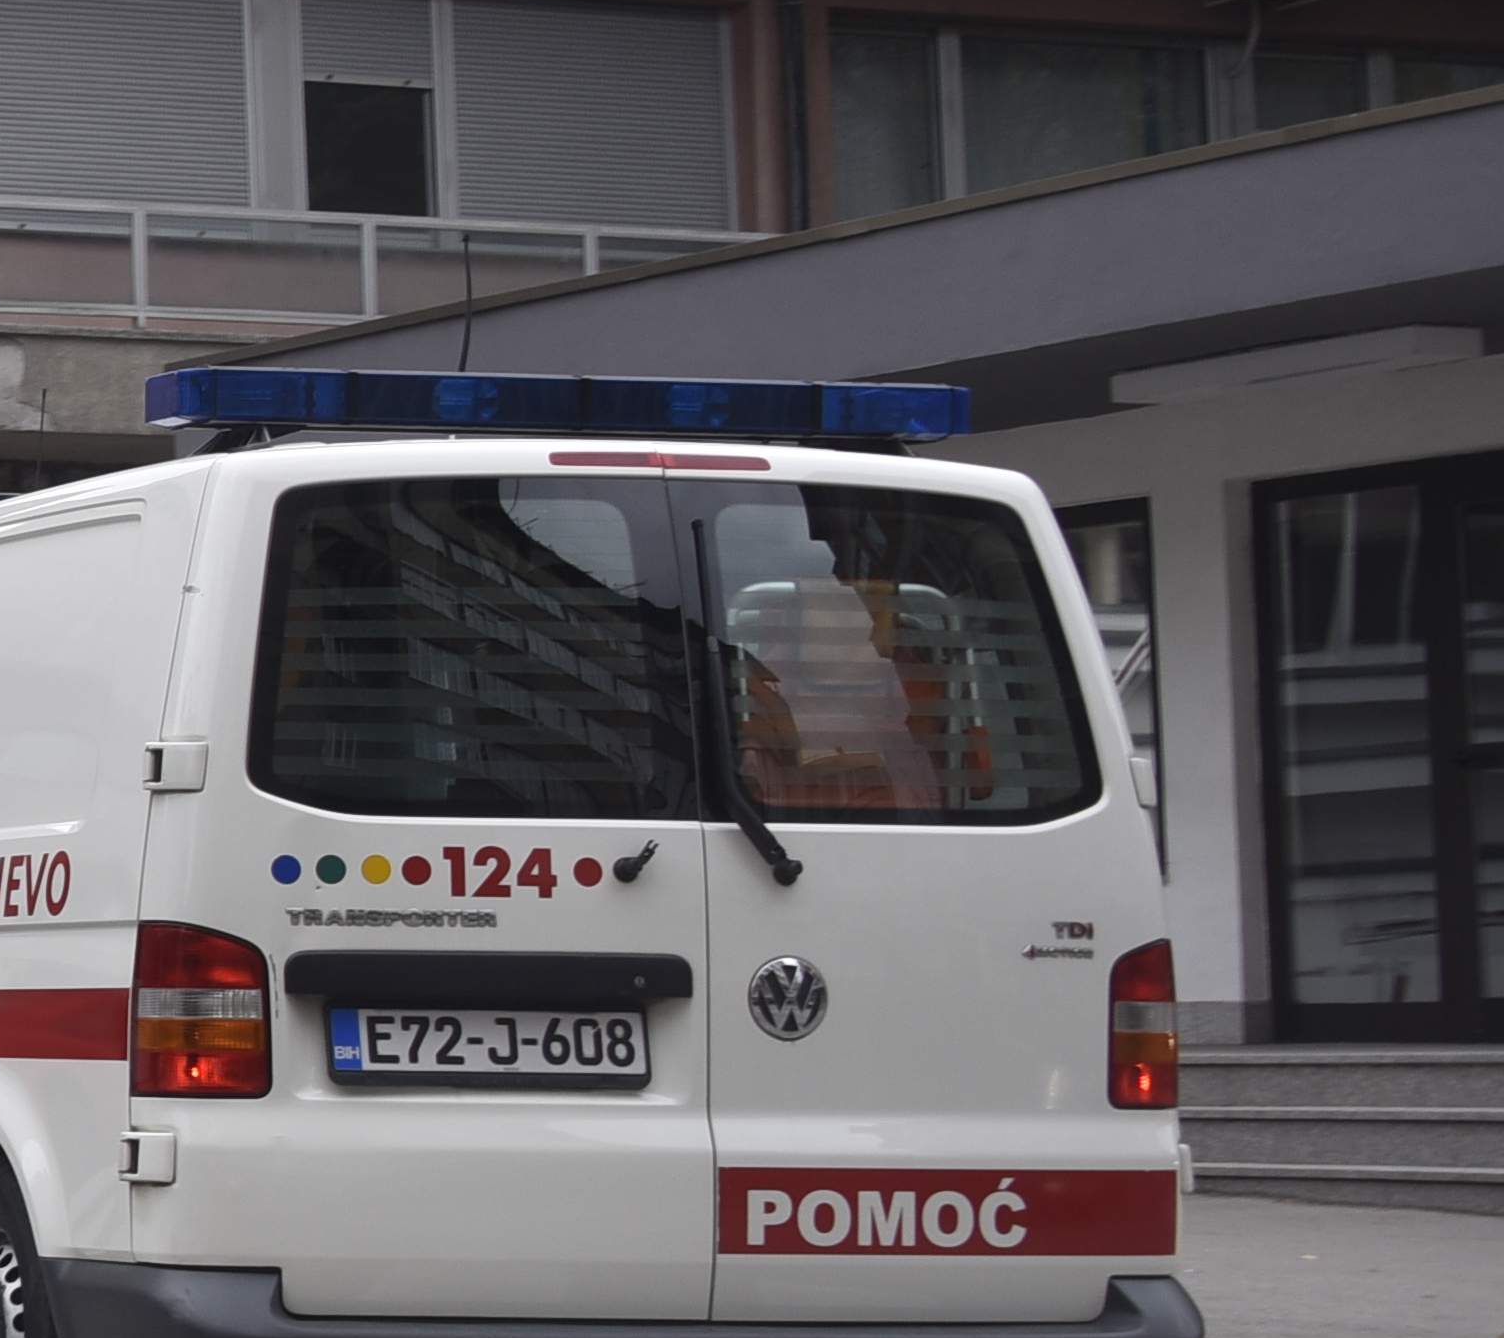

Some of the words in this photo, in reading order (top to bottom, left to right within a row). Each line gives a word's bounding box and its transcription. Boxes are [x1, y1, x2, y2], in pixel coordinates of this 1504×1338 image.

[442, 845, 558, 899] 124
[285, 907, 498, 928] TRANSPORTER
[333, 1045, 361, 1061] BIH
[365, 1015, 637, 1069] E72-J-608
[746, 1176, 1028, 1249] POMOĆ
